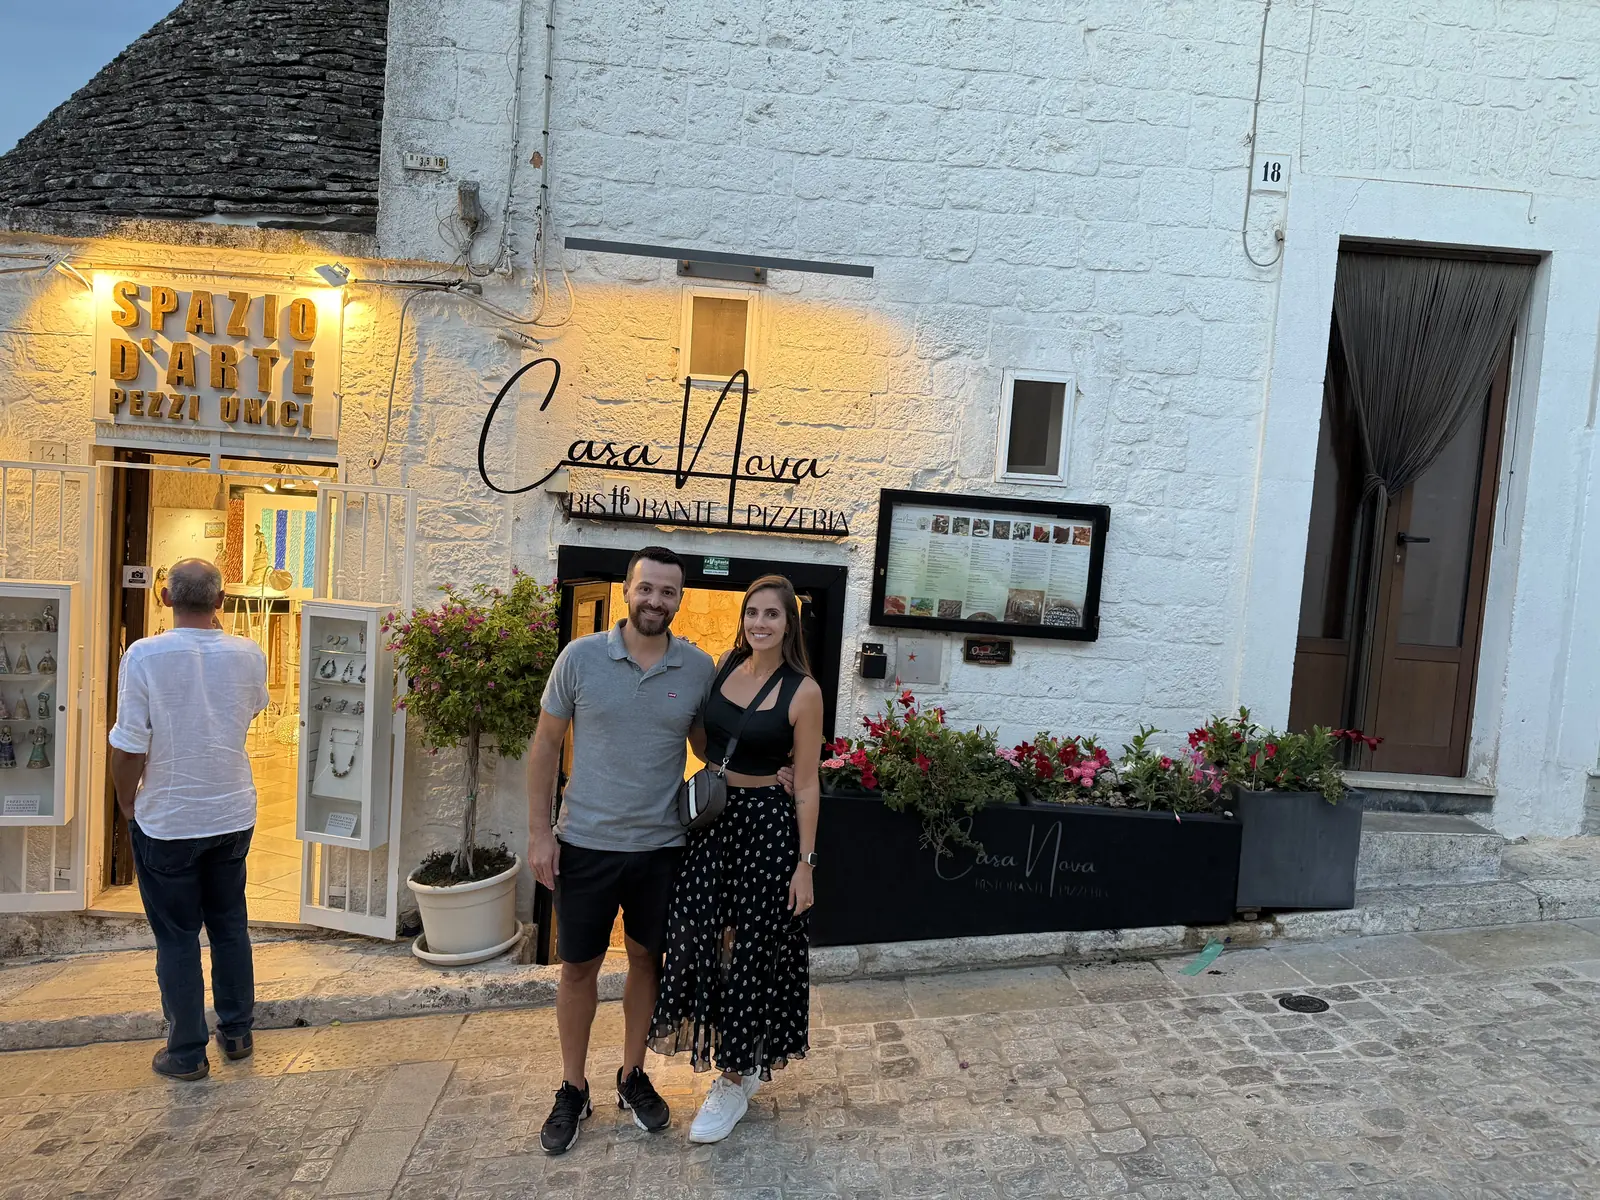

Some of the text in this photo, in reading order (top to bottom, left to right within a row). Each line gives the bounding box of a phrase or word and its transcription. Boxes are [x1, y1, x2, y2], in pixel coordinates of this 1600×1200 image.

[1262, 161, 1281, 182] 18
[111, 281, 316, 342] SPAZIO
[110, 338, 315, 395] D'ARTE
[109, 388, 313, 429] PEZZI UNICI
[40, 446, 56, 461] 14
[478, 357, 832, 526] Casa Nova
[569, 492, 849, 532] RISTORANTE PIZZERIA
[935, 816, 1097, 898] Casa Nova
